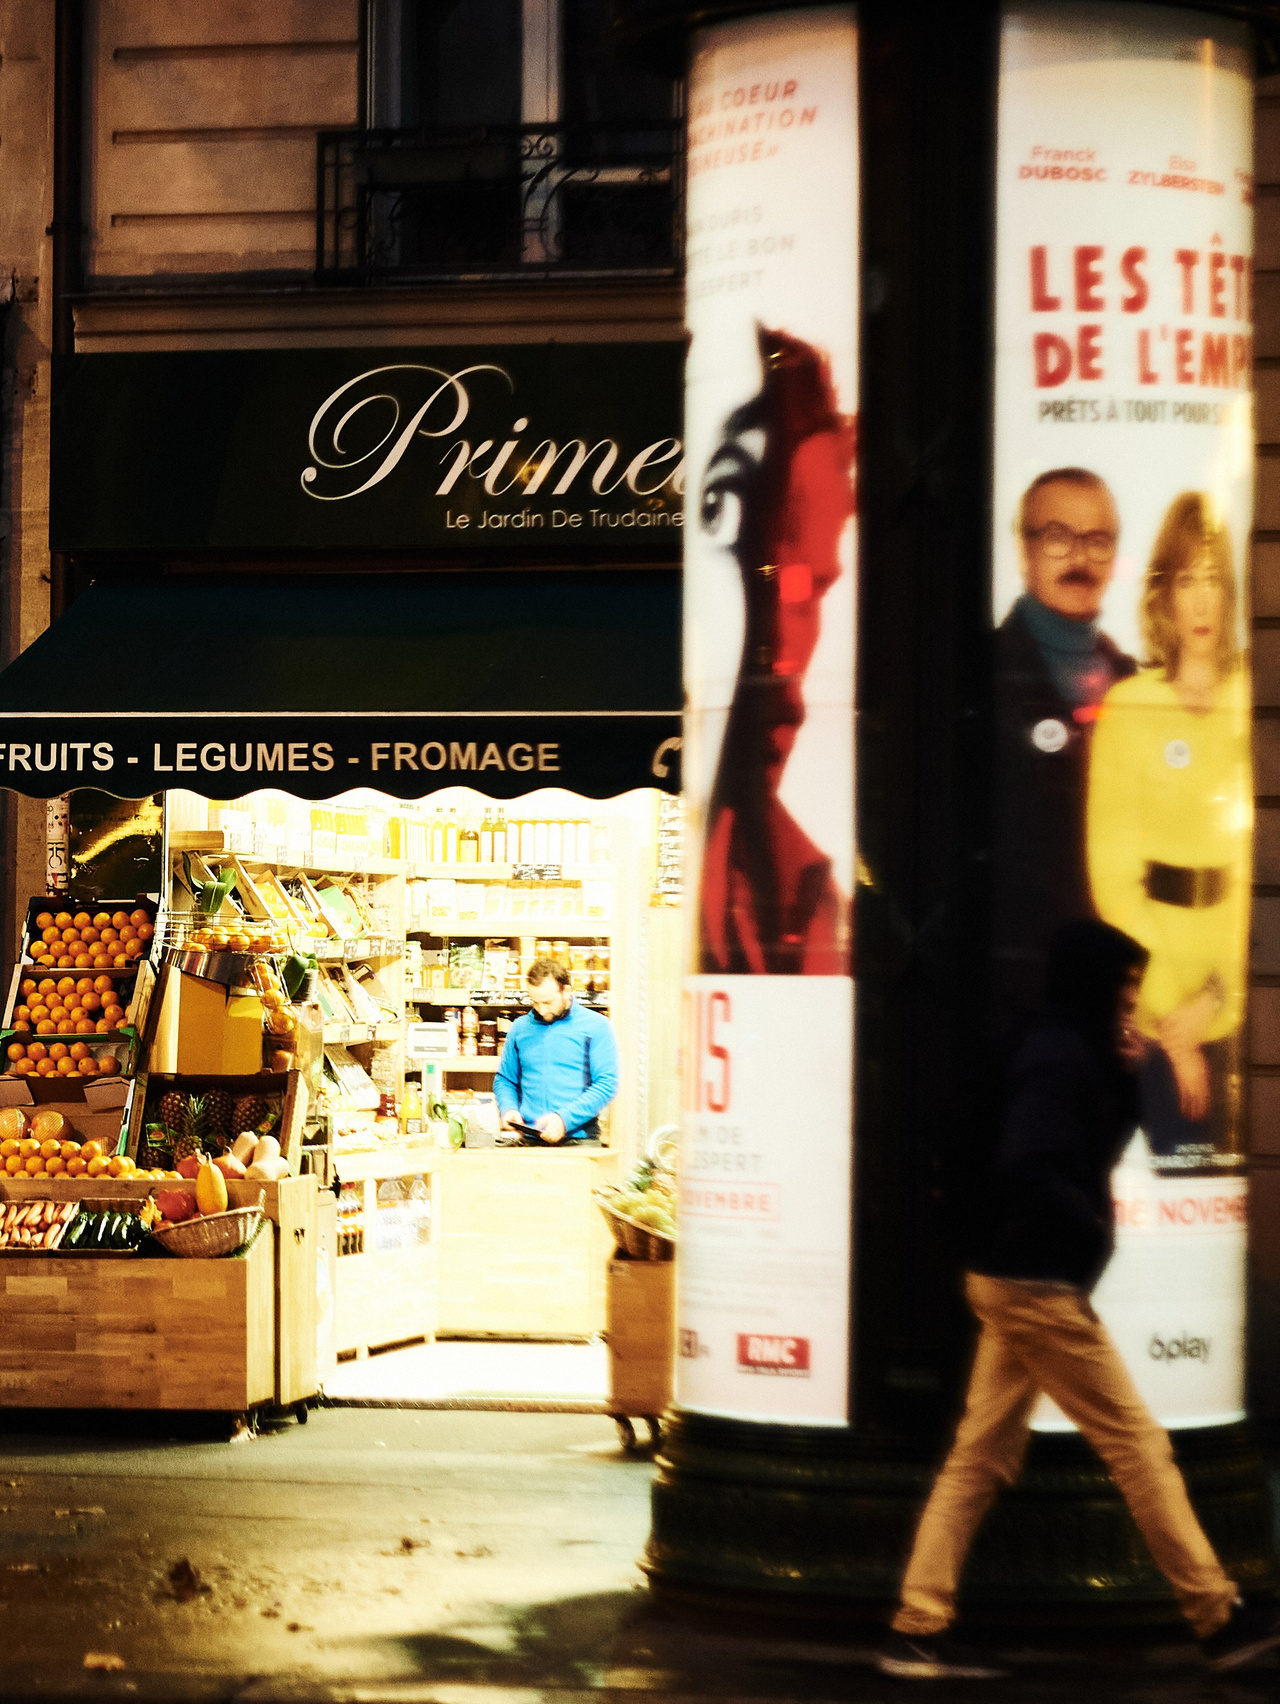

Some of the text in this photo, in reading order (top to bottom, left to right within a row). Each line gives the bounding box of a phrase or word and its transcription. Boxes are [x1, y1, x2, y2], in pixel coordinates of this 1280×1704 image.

[721, 78, 799, 112] COEUR
[1030, 145, 1097, 163] Franck
[1017, 164, 1108, 183] DUBOSC
[748, 233, 796, 256] BON
[1028, 231, 1251, 321] LES TÊT
[1032, 323, 1105, 389] DE
[1124, 399, 1168, 424] TOUT
[445, 507, 685, 529] Le Jardin De Trudaine
[153, 741, 335, 773] LEGUMES
[371, 741, 561, 773] FROMAGE
[747, 1337, 797, 1365] RMC
